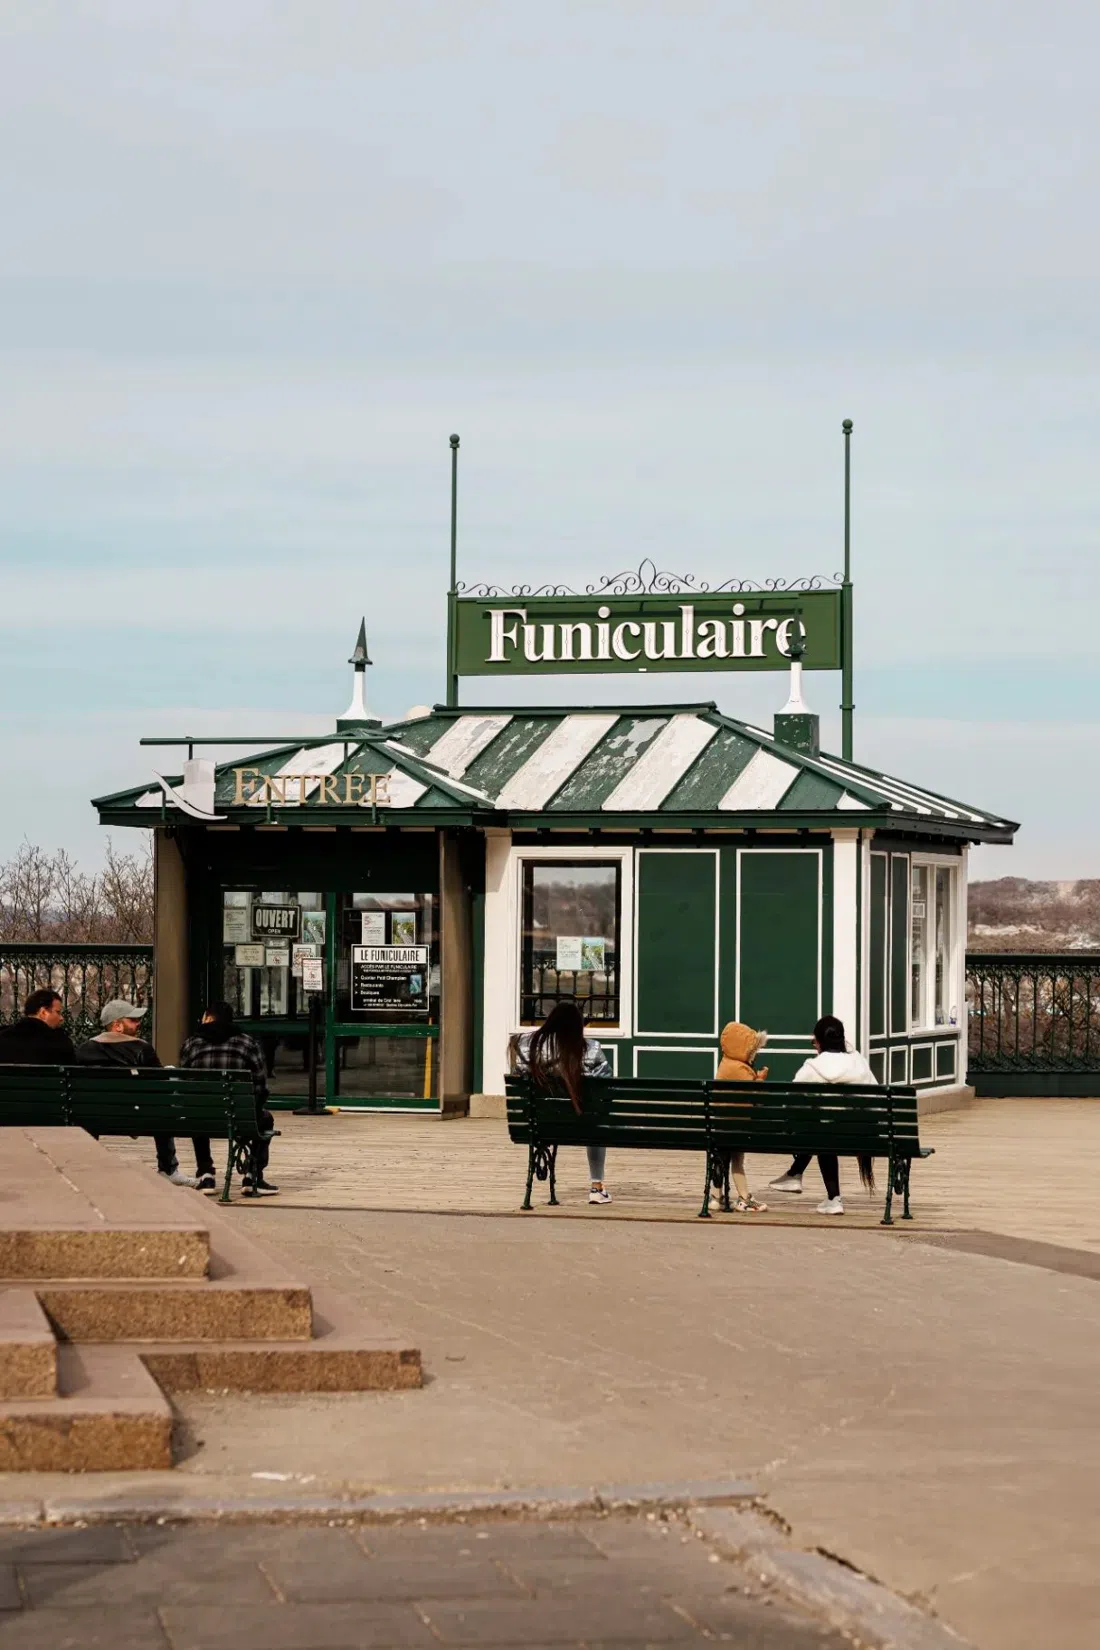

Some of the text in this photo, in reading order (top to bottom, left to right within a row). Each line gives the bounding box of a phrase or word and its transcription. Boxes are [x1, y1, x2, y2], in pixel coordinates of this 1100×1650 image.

[484, 603, 807, 663] Funiculaire
[232, 765, 392, 805] ENTRÉE
[255, 908, 296, 928] OUVERT
[360, 949, 420, 961] LE FUNICULAIRE
